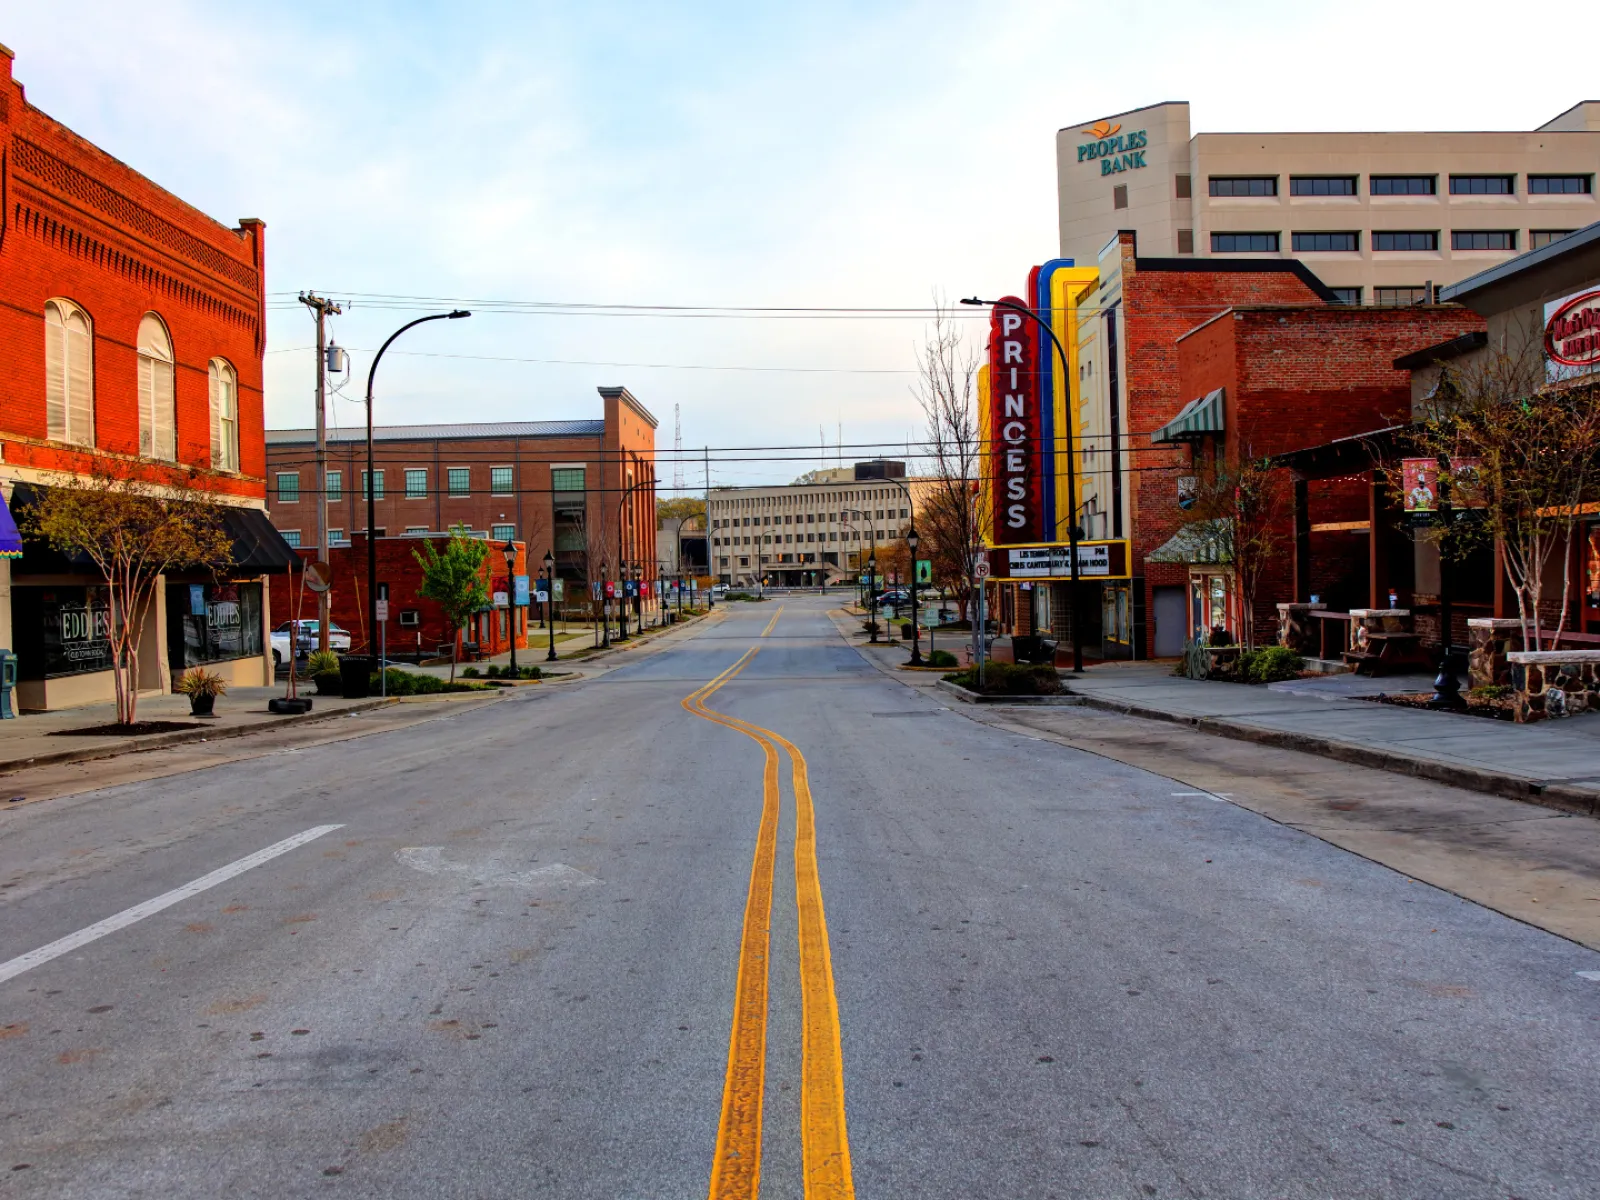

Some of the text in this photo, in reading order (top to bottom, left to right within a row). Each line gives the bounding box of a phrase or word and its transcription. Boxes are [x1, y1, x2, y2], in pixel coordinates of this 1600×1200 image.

[1077, 129, 1147, 162] PEOPLES
[1100, 150, 1147, 176] BANK
[1002, 313, 1027, 529] PRINCESS
[62, 611, 110, 639] EDDIES
